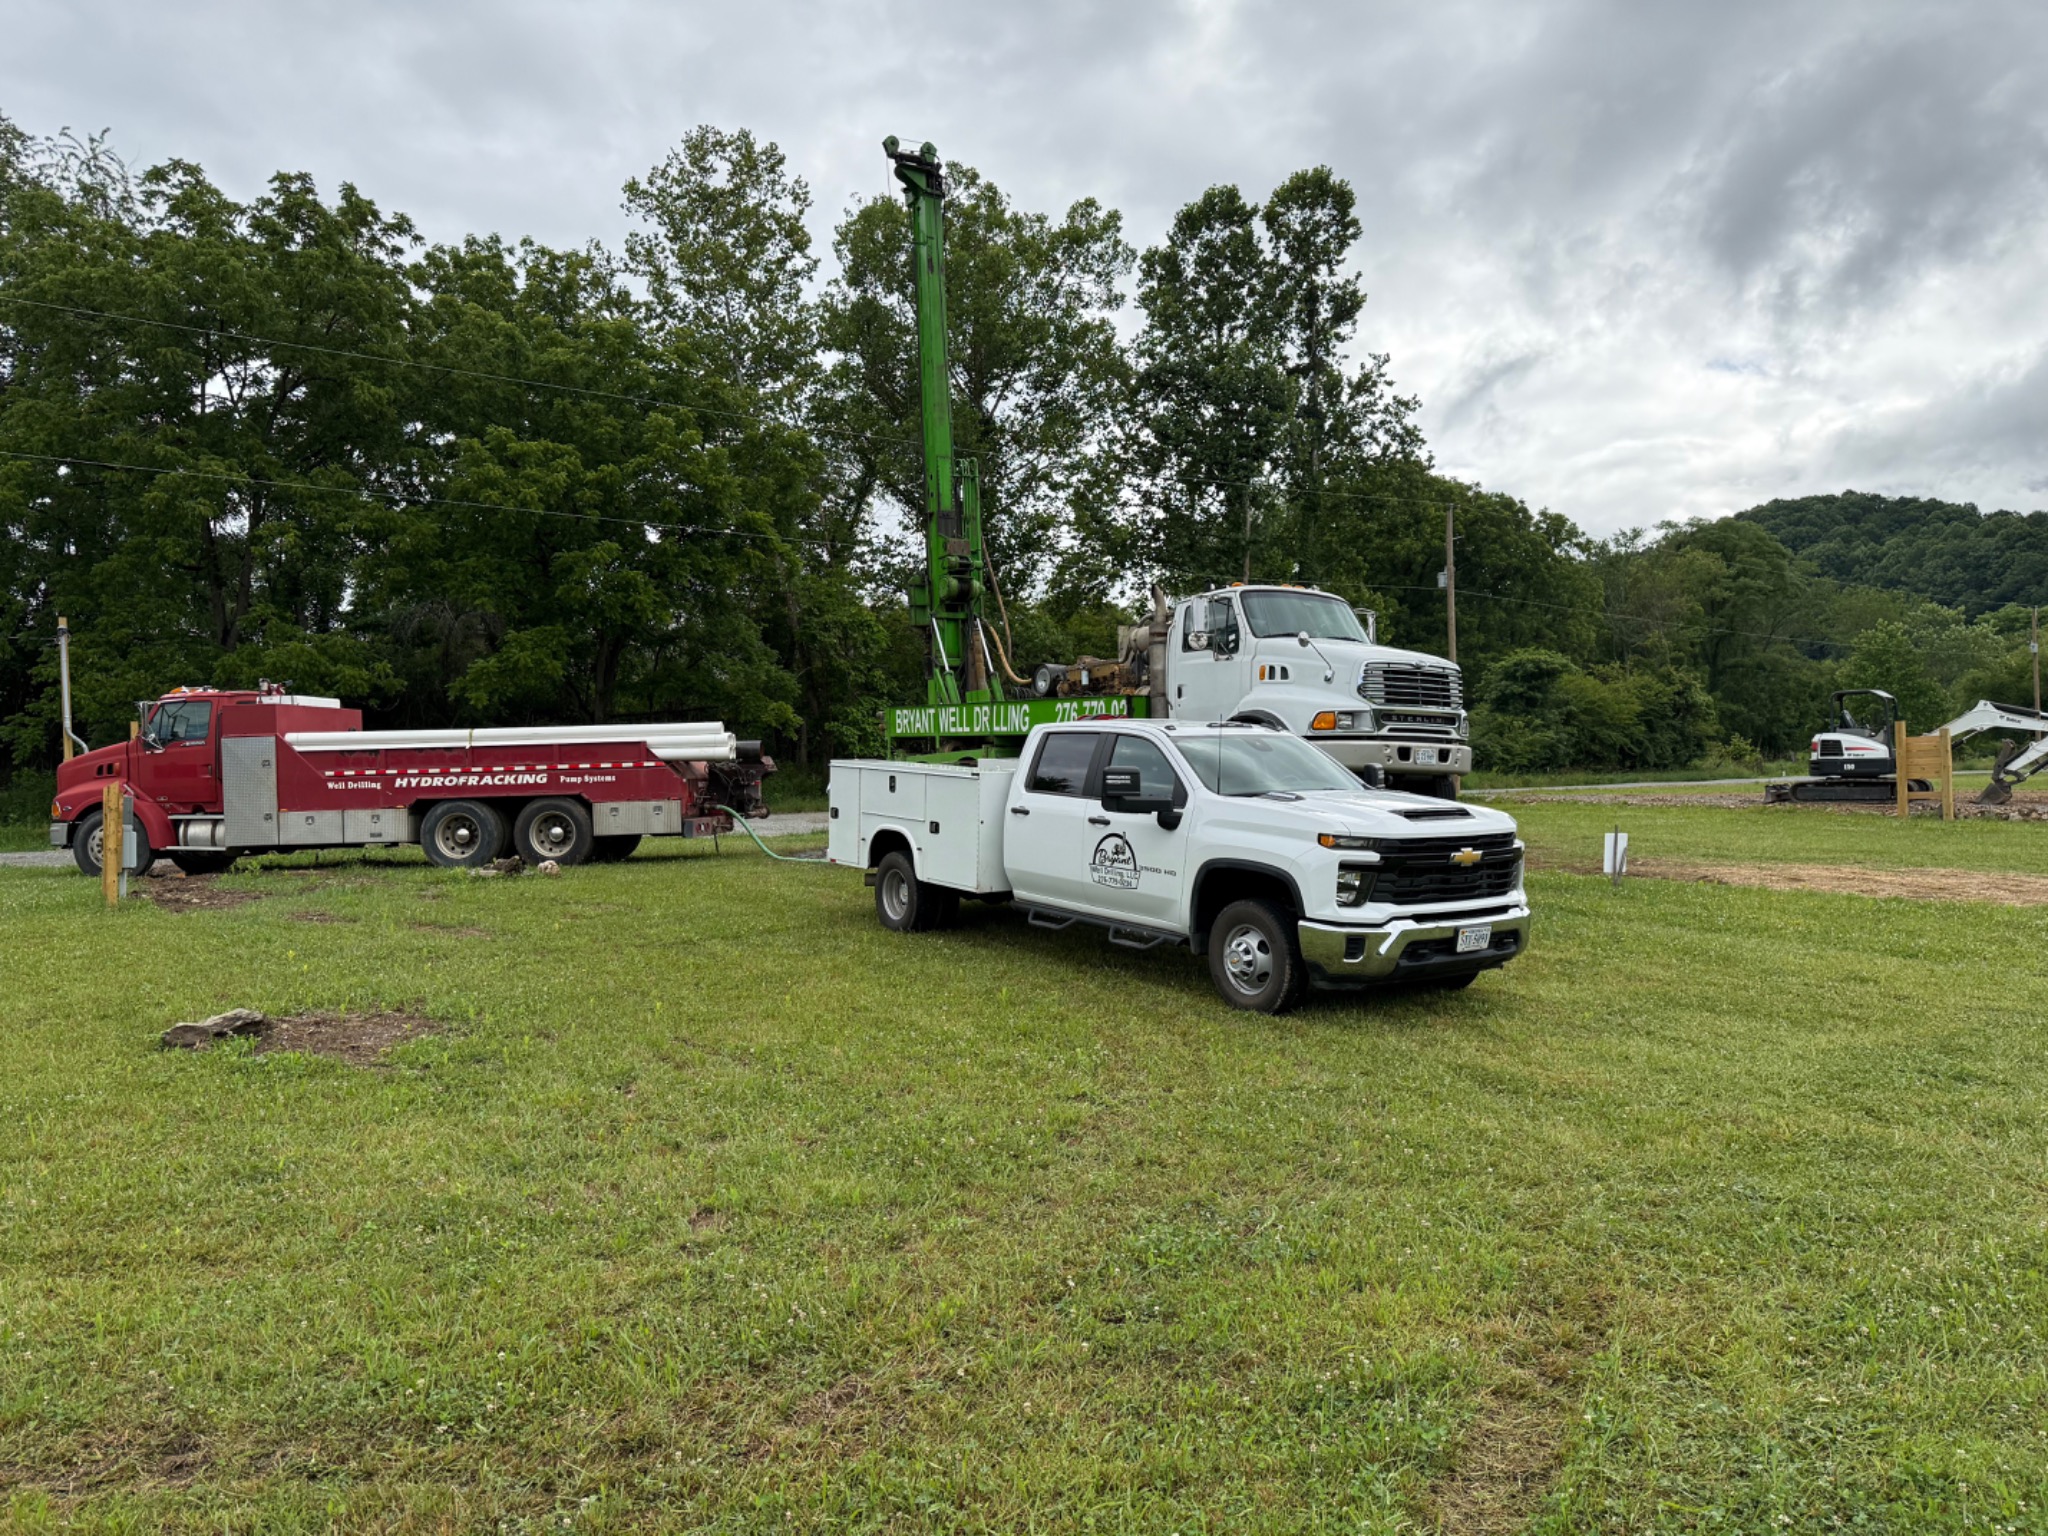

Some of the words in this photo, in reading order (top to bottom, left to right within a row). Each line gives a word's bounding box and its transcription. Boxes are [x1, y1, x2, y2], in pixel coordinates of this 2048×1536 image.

[895, 708, 935, 734] BRYANT
[938, 706, 970, 733] WELL
[973, 703, 1030, 732] DRLLING
[1391, 715, 1447, 724] STERLIN
[327, 780, 345, 790] Well
[347, 779, 382, 790] Drilling
[394, 773, 548, 788] HYDROFRACKING
[559, 775, 582, 784] Pump
[584, 773, 616, 784] Systems
[1097, 848, 1132, 867] Bryant
